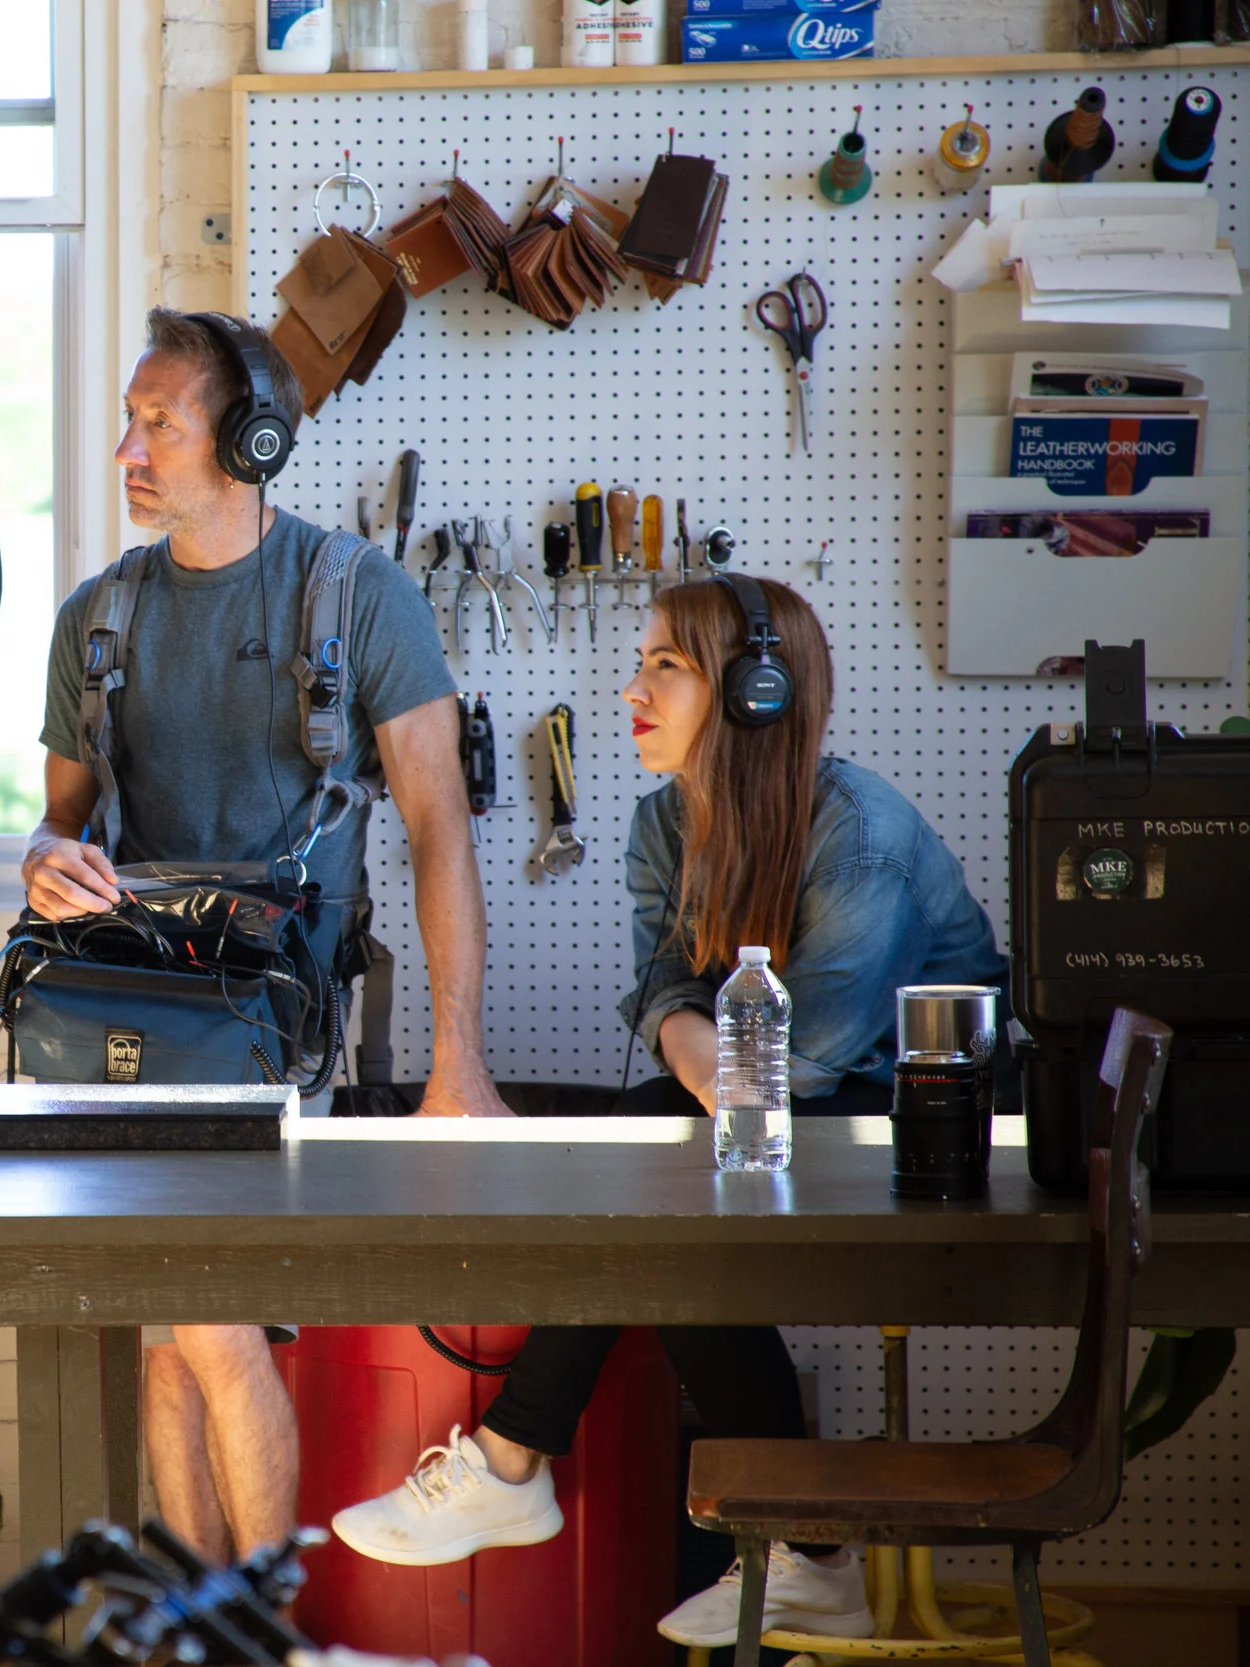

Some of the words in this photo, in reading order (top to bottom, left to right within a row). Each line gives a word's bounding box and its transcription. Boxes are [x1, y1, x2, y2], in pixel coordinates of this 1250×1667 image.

[1020, 425, 1044, 437] THE
[1019, 441, 1176, 456] LEATHERWORKING
[1017, 459, 1095, 471] HANDBOOK
[1078, 822, 1125, 838] MKE
[1144, 821, 1250, 836] PRODUCTIO
[1090, 861, 1127, 874] MKE
[1066, 952, 1109, 967] (414)
[1116, 952, 1205, 968] 939-3653
[111, 1043, 137, 1060] porta
